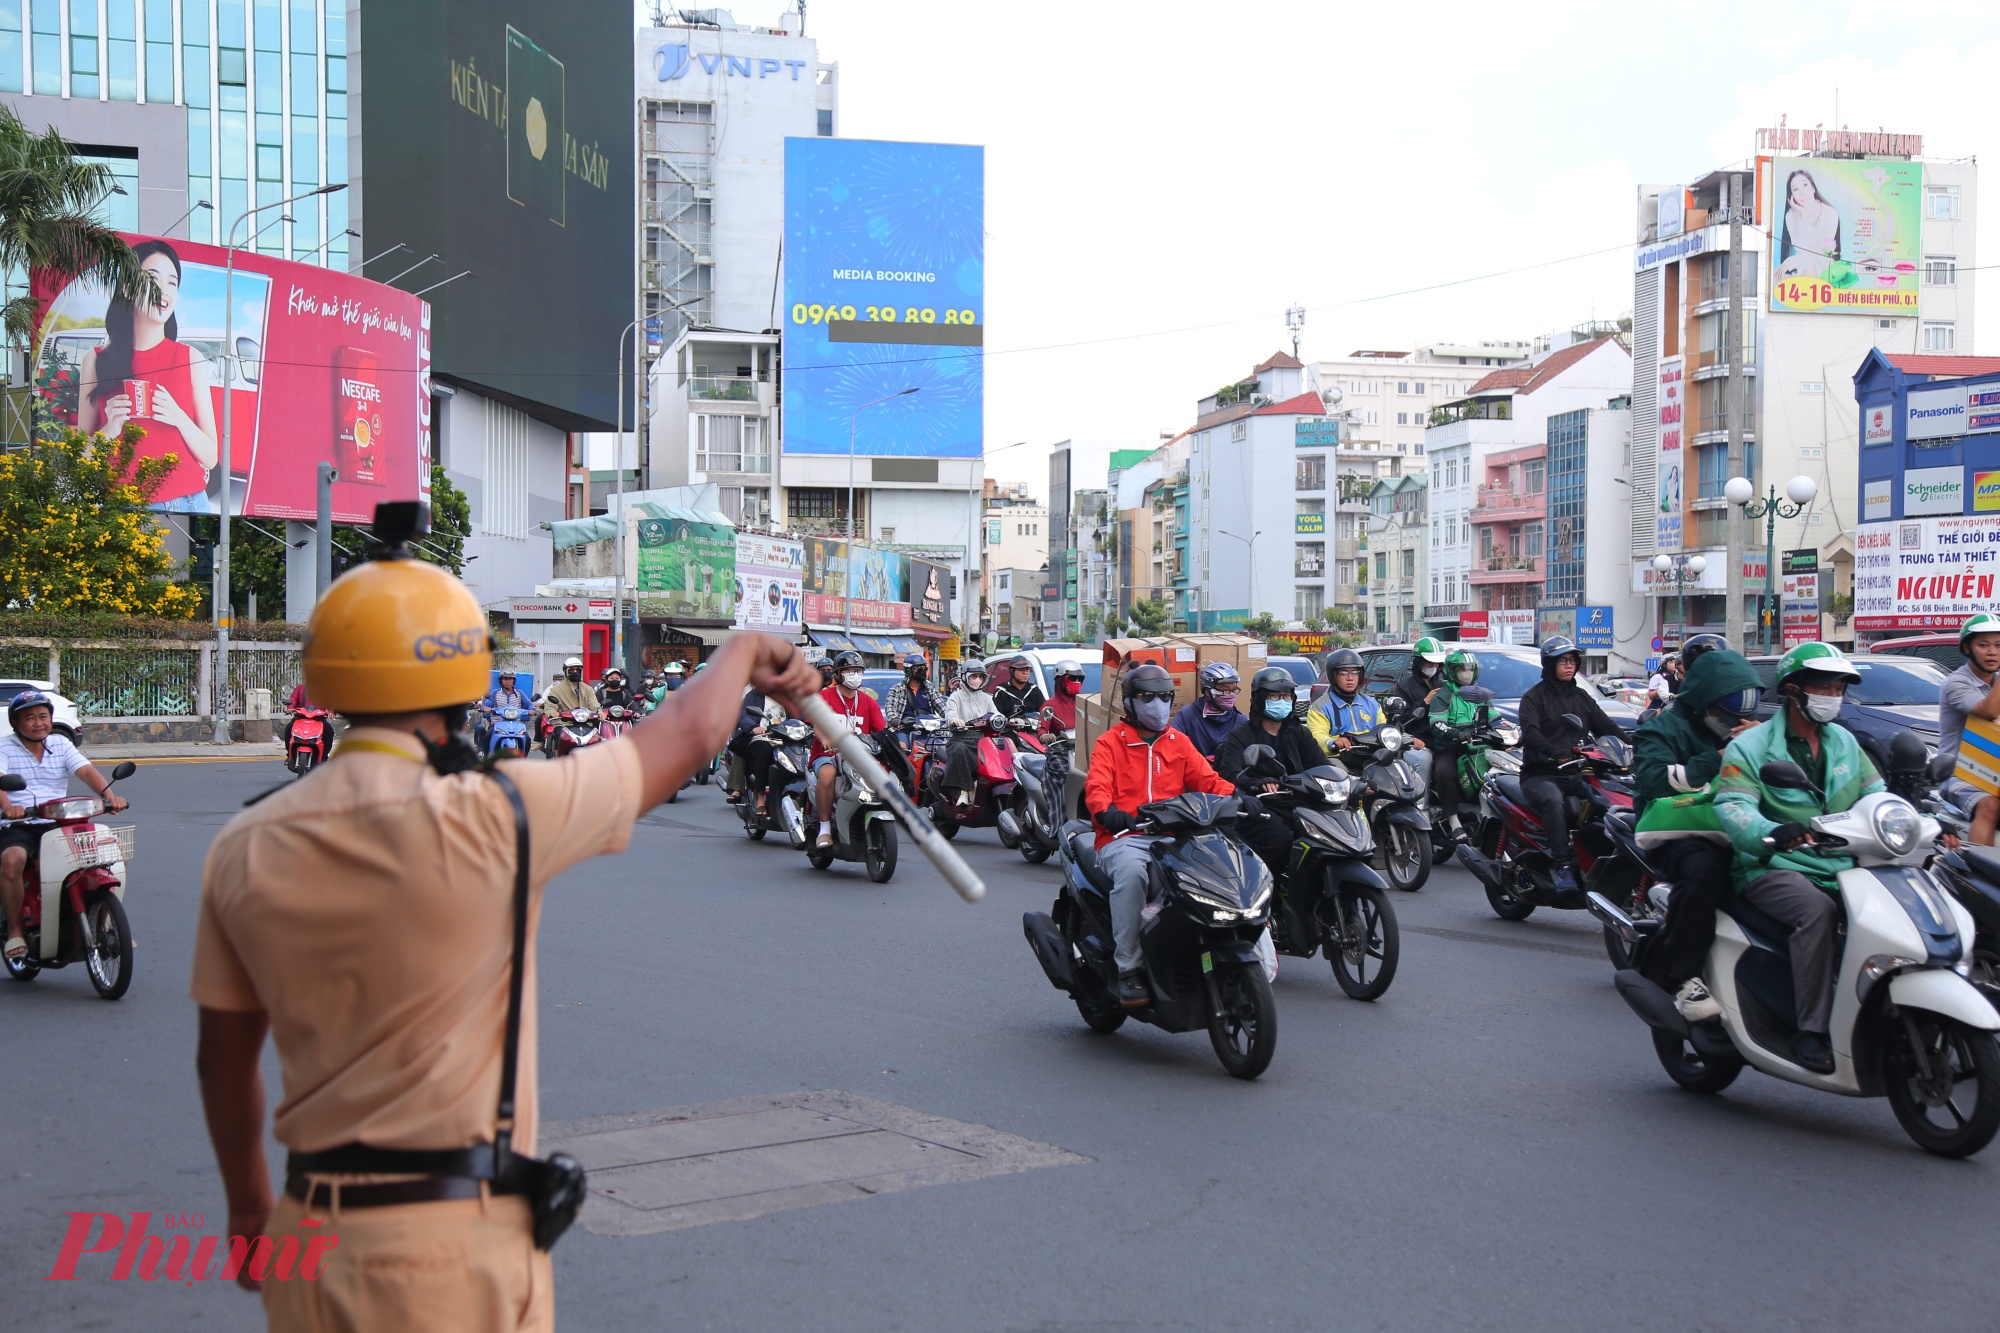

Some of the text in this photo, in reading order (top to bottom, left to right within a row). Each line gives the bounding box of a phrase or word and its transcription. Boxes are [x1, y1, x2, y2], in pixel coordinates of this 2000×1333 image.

[698, 53, 806, 81] VNPT
[1758, 113, 1800, 150] THẨM
[1896, 134, 1922, 155] ANH
[833, 268, 936, 282] MEDIA BOOKING
[1778, 283, 1832, 304] 14-16
[1838, 292, 1858, 306] ĐIỆN
[1860, 292, 1880, 304] BIÊN
[342, 299, 362, 325] thế
[384, 312, 399, 334] của
[400, 316, 412, 341] bạn
[1910, 404, 1965, 419] Panasonic
[1319, 435, 1337, 444] SPA
[1662, 430, 1680, 451] ANH
[1907, 481, 1961, 496] Schneider
[1930, 492, 1960, 500] Electric
[1865, 495, 1890, 505] SENKO
[1938, 530, 1958, 544] THẾ
[1962, 530, 1984, 544] GIỚI
[1303, 554, 1315, 562] SPA
[1900, 547, 1996, 564] TRUNG TÂM THIẾT
[1300, 562, 1319, 572] KALIN
[1897, 565, 1994, 600] NGUYỄN
[782, 598, 798, 622] 7K
[1934, 603, 1950, 613] Điện
[1952, 603, 1968, 612] Biên
[1898, 617, 1958, 626] HOTLINE: 0909
